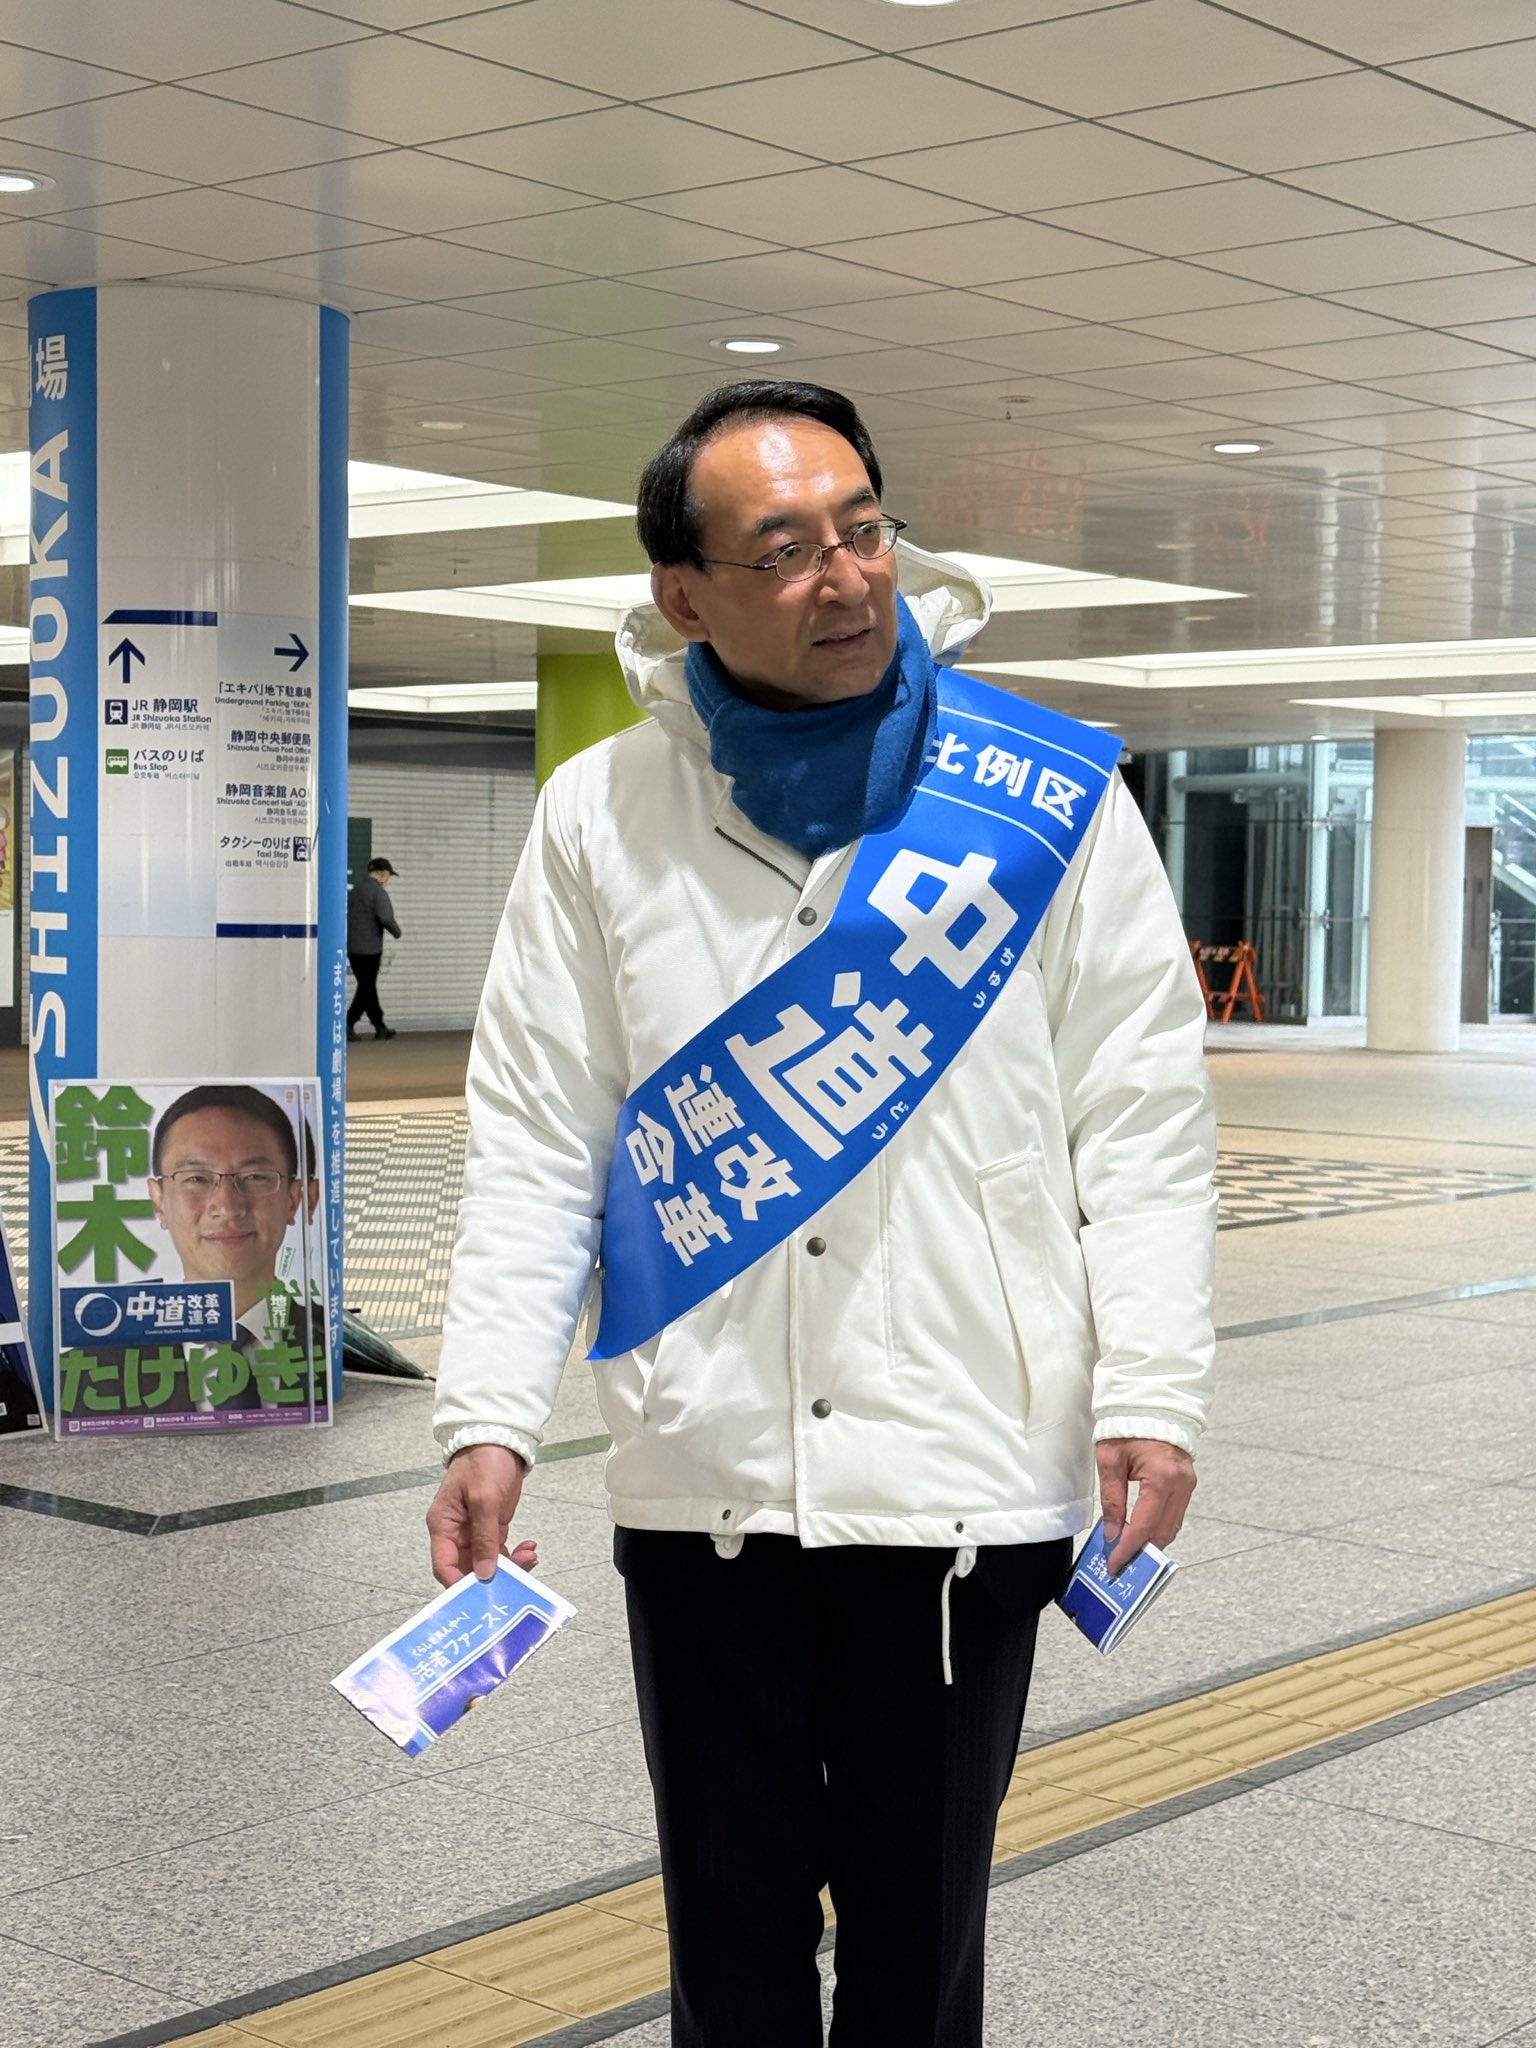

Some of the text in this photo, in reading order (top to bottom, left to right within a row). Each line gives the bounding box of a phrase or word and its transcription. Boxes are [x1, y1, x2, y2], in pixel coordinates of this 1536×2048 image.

[30, 333, 69, 401] 場
[132, 698, 198, 713] JR 静岡駅
[215, 697, 263, 706] Underground
[265, 698, 290, 709] Parking
[131, 713, 212, 723] JR Shizuoka Station
[30, 428, 69, 1059] SHIZUOKA
[231, 730, 311, 747] 静岡中央郵便局
[226, 743, 259, 752] Shizuoka
[134, 749, 204, 763] バスのりば
[133, 763, 168, 773] Bus Stop
[225, 783, 287, 798] 静岡音楽館
[216, 797, 250, 805] Shizuoka
[251, 798, 280, 806] Concert
[220, 835, 291, 849] タクシーのりば
[256, 850, 288, 860] Taxi Stop
[724, 848, 1019, 1162] 中道
[55, 1085, 157, 1283] 鈴木
[126, 1290, 186, 1327] 中道
[187, 1293, 220, 1309] 改革
[187, 1308, 221, 1325] 連合
[60, 1342, 306, 1412] たけゆき
[411, 1604, 509, 1684] 活者ファースト
